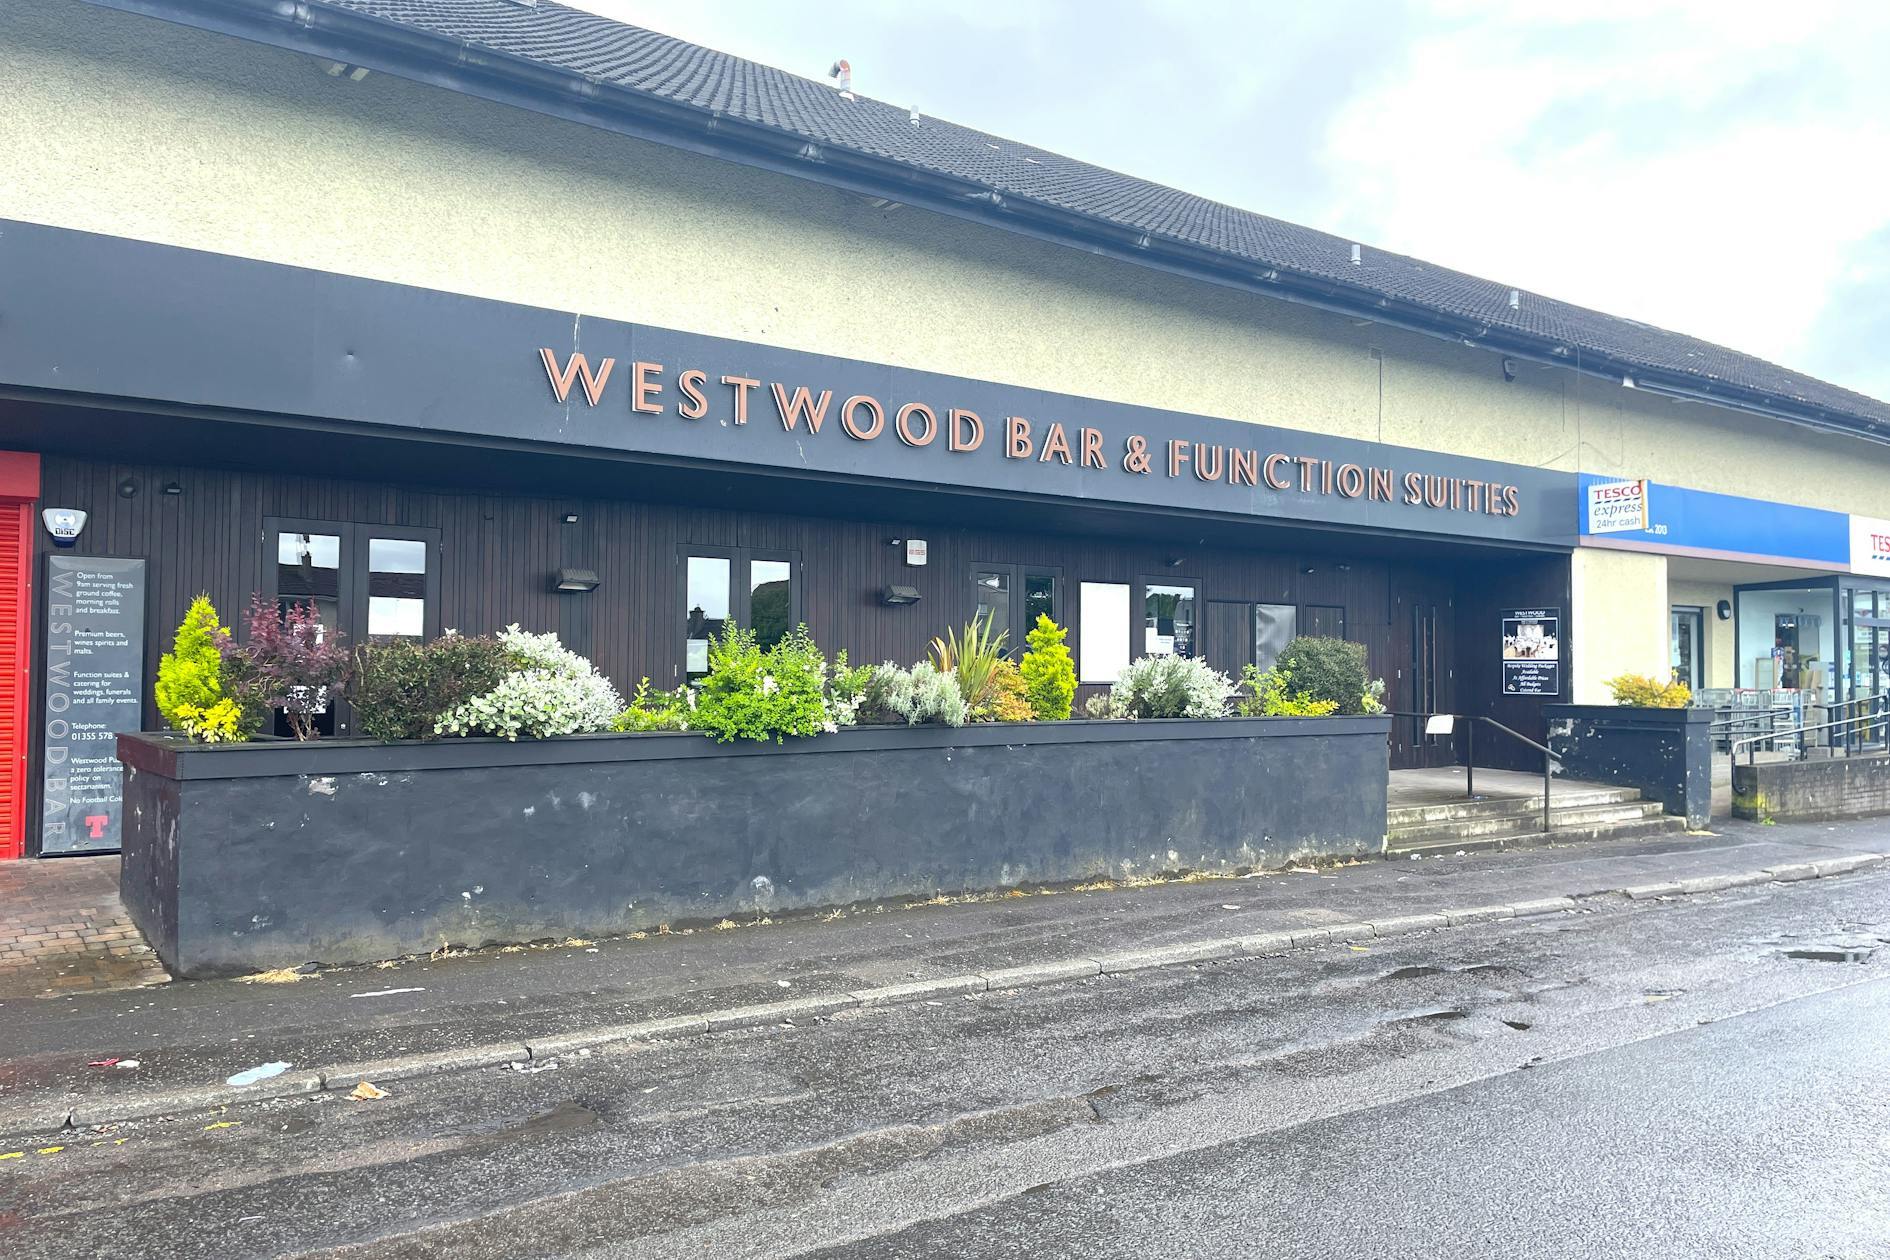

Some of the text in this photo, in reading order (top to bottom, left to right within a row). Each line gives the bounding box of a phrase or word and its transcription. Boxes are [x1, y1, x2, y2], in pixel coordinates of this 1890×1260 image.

[539, 348, 1518, 517] WESTWOOD BAR & FUNCTION SUITES
[1593, 485, 1641, 500] TESCO
[1594, 503, 1642, 518] express
[1596, 516, 1640, 529] 24hr cash
[97, 572, 113, 580] from
[76, 580, 133, 590] 9am serving fresh
[76, 590, 99, 598] ground
[76, 599, 103, 607] morning
[74, 630, 104, 638] Premium
[73, 680, 100, 688] catering
[45, 571, 73, 837] WESTWOOD BAR
[96, 697, 114, 705] family
[71, 732, 96, 741] 01355
[98, 731, 113, 740] 578
[70, 774, 90, 783] policy
